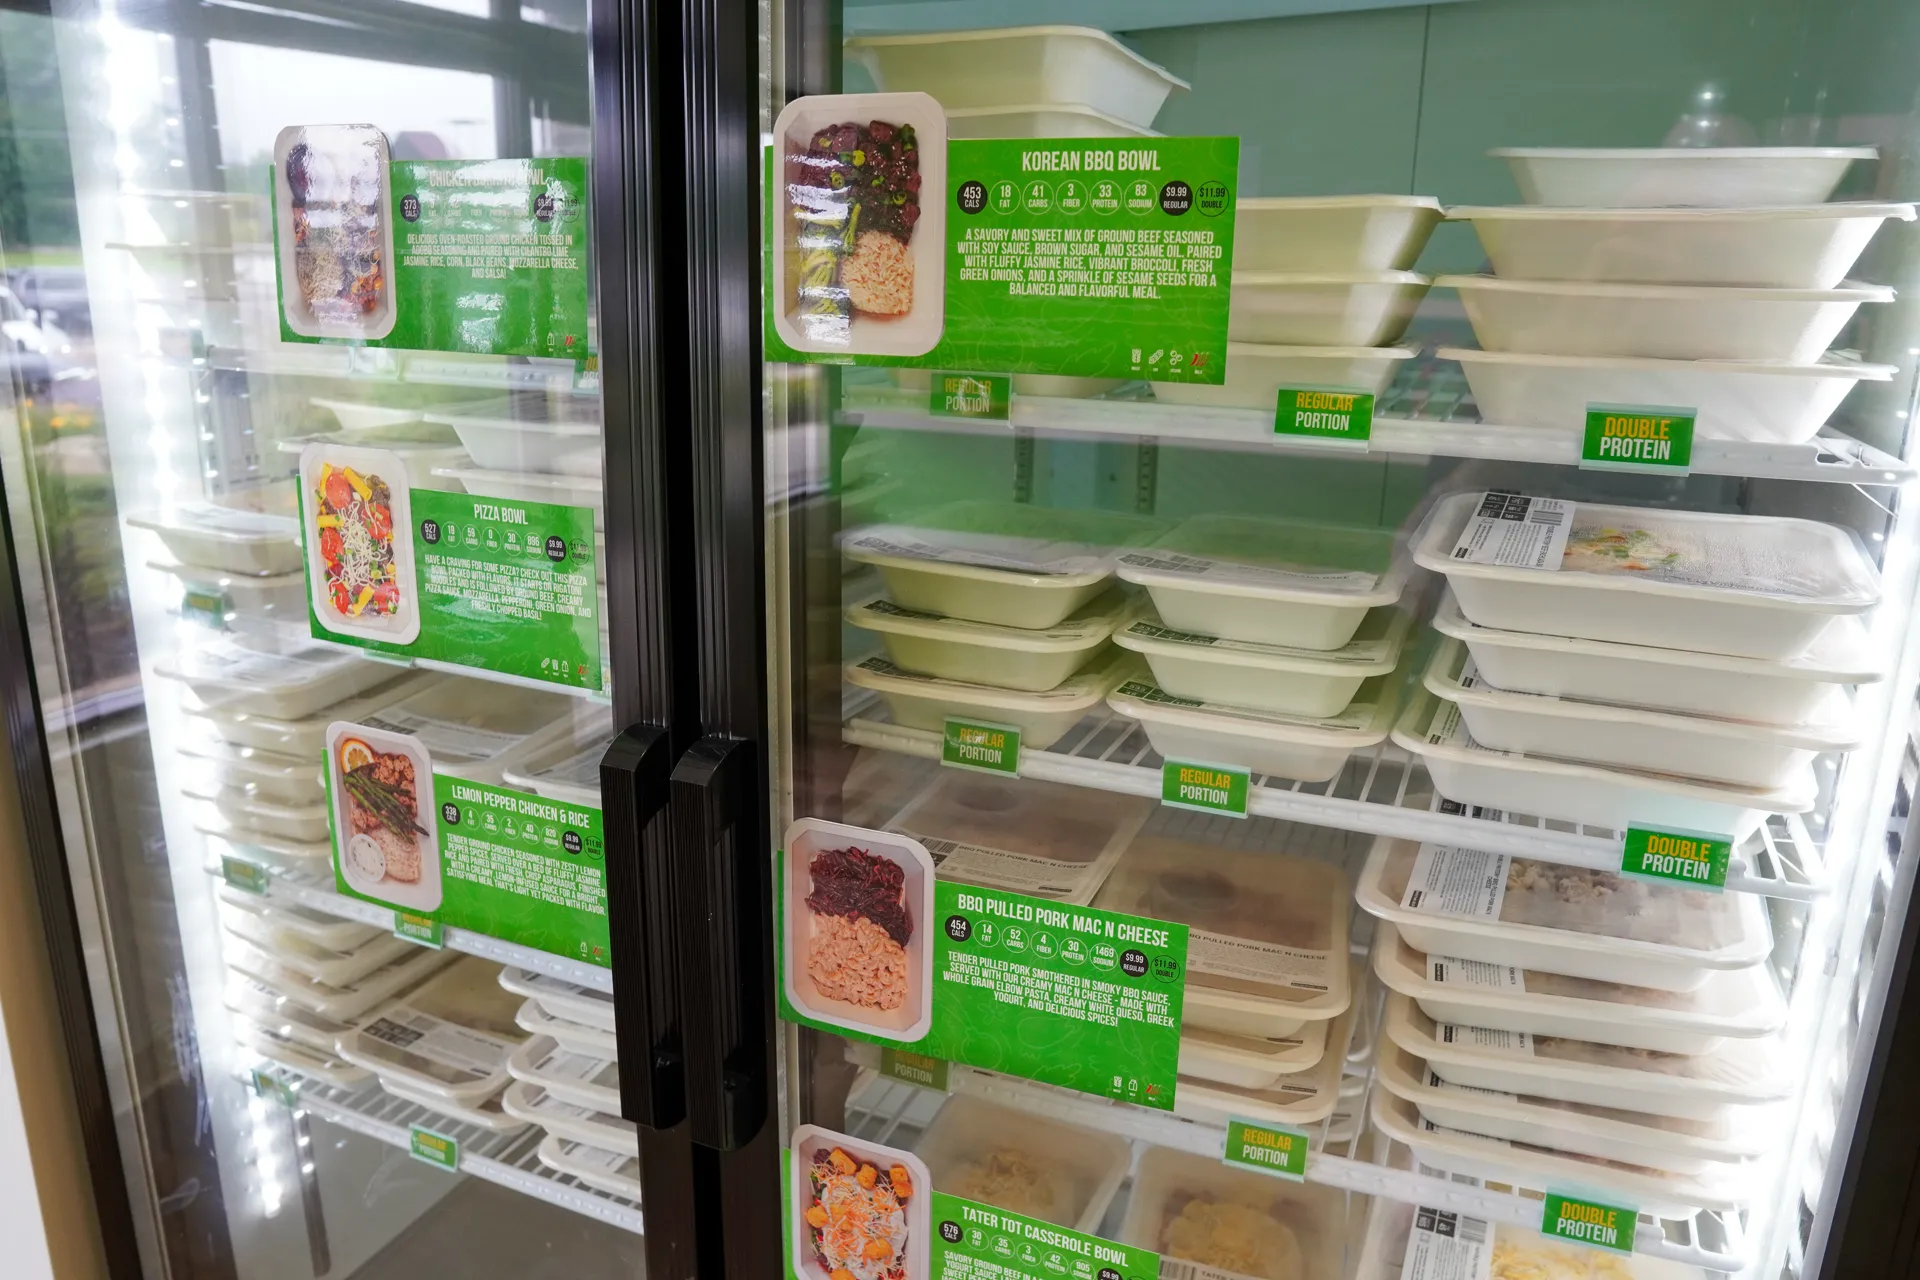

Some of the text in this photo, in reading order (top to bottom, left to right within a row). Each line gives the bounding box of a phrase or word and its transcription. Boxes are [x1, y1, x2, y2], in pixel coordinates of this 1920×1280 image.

[1022, 150, 1160, 170] KOREAN BBQ BOWL
[963, 186, 981, 199] 453
[1000, 185, 1011, 198] 18
[1032, 185, 1043, 198] 41
[1067, 184, 1074, 196] 3
[1099, 185, 1111, 197] 33
[1135, 184, 1146, 196] 83
[1166, 186, 1186, 197] $9.99
[1199, 186, 1225, 198] $11.99
[404, 199, 416, 209] 373
[964, 198, 979, 208] CALS
[999, 199, 1009, 208] FAT
[1028, 198, 1047, 208] CARBS
[1062, 198, 1080, 207] FIBER
[1092, 198, 1117, 208] PROTEIN
[1128, 198, 1152, 208] SODIUM
[1163, 199, 1188, 209] REGULAR
[1201, 199, 1222, 209] DOUBLE
[965, 228, 1213, 244] A SAVORY AND SWEET MIX OF GROUND BEEF SEASONED
[1009, 282, 1055, 295] BALANCED
[1057, 283, 1076, 296] AND
[1078, 284, 1130, 297] FLAVORFUL
[945, 395, 990, 413] PORTION
[1296, 392, 1353, 412] REGULAR
[1295, 411, 1349, 432] PORTION
[1604, 416, 1671, 439] DOUBLE
[1600, 436, 1671, 460] PROTEIN
[473, 503, 528, 524] PIZZA BOWL
[424, 523, 436, 533] 527
[447, 524, 454, 534] 19
[467, 527, 475, 537] 59
[488, 529, 492, 538] 0
[507, 532, 515, 542] 30
[527, 535, 539, 546] 896
[959, 727, 1005, 748] REGULAR
[959, 745, 1002, 764] PORTION
[1180, 768, 1231, 789] REGULAR
[1180, 785, 1228, 805] PORTION
[452, 784, 589, 828] LEMON PEPPER CHICKEN & RICE
[468, 810, 472, 818] 4
[507, 818, 511, 827] 2
[525, 823, 533, 833] 40
[1647, 835, 1711, 862] DOUBLE
[976, 849, 1005, 857] PULLED
[1007, 854, 1028, 862] PORK
[1642, 853, 1710, 880] PROTEIN
[950, 918, 966, 931] 454
[958, 893, 1169, 948] BBQ PULLED PORK MAC N CHEESE
[951, 928, 964, 937] CALS
[982, 923, 992, 935] 14
[1010, 928, 1020, 940] 52
[981, 934, 990, 943] FAT
[1006, 938, 1023, 949] CARBS
[1040, 934, 1046, 944] 4
[1036, 944, 1051, 954] FIBER
[1068, 940, 1078, 952] 30
[1095, 945, 1114, 958] 1469
[1203, 936, 1235, 946] PULLED
[1237, 943, 1260, 951] PORK
[1263, 947, 1282, 955] MAC
[1061, 950, 1083, 961] PROTEIN
[1092, 955, 1114, 967] SODIUM
[1125, 952, 1143, 964] $9.99
[1123, 962, 1144, 973] REGULAR
[1154, 958, 1176, 971] $11.99
[948, 950, 977, 967] TENDER
[979, 956, 1008, 973] PULLED
[1009, 962, 1030, 978] PORK
[1032, 967, 1080, 988] SMOTHERED
[1081, 978, 1090, 989] IN
[1092, 980, 1121, 995] SMOKY
[1122, 986, 1139, 999] BBQ
[1155, 968, 1174, 978] DOUBLE
[1027, 998, 1043, 1010] AND
[1045, 1002, 1085, 1020] DELICIOUS
[1087, 1011, 1119, 1027] SPICES!
[895, 1063, 933, 1083] PORTION
[1243, 1128, 1292, 1151] REGULAR
[1243, 1144, 1288, 1167] PORTION
[1561, 1201, 1617, 1228] DOUBLE
[943, 1222, 958, 1235] 576
[971, 1229, 981, 1240] 30
[1556, 1218, 1617, 1245] PROTEIN
[944, 1231, 956, 1241] CALS
[962, 1205, 1128, 1267] TATER TOT CASSEROLE BOWL
[972, 1238, 980, 1247] FAT
[998, 1237, 1007, 1248] 35
[1025, 1244, 1030, 1254] 3
[1050, 1253, 1060, 1264] 42
[945, 1250, 1020, 1280] SAVORY GROUND BEEF
[1044, 1260, 1065, 1272] PROTEIN
[1076, 1260, 1089, 1273] 905
